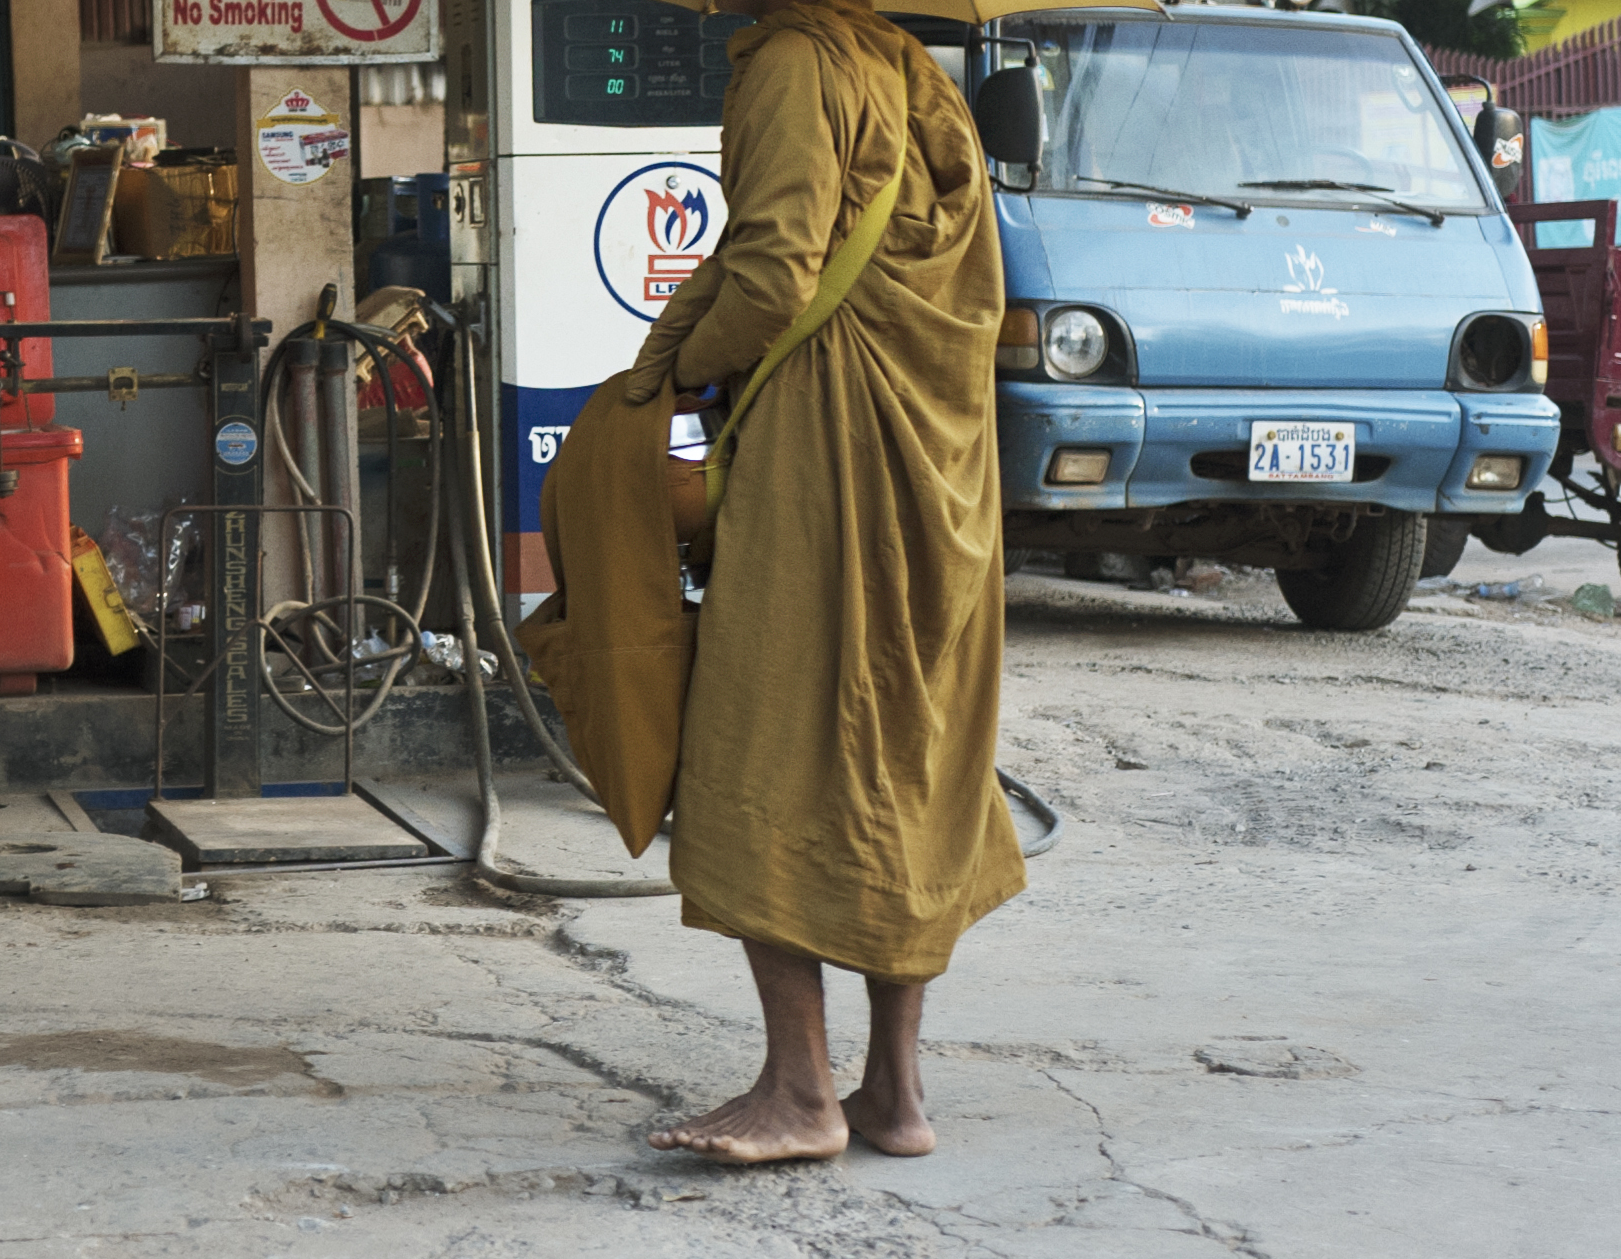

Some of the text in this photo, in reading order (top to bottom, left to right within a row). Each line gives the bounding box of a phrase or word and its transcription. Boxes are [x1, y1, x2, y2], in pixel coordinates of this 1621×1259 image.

[610, 19, 624, 34] 11
[608, 48, 624, 63] 74
[607, 78, 624, 95] 00
[655, 283, 680, 294] LP
